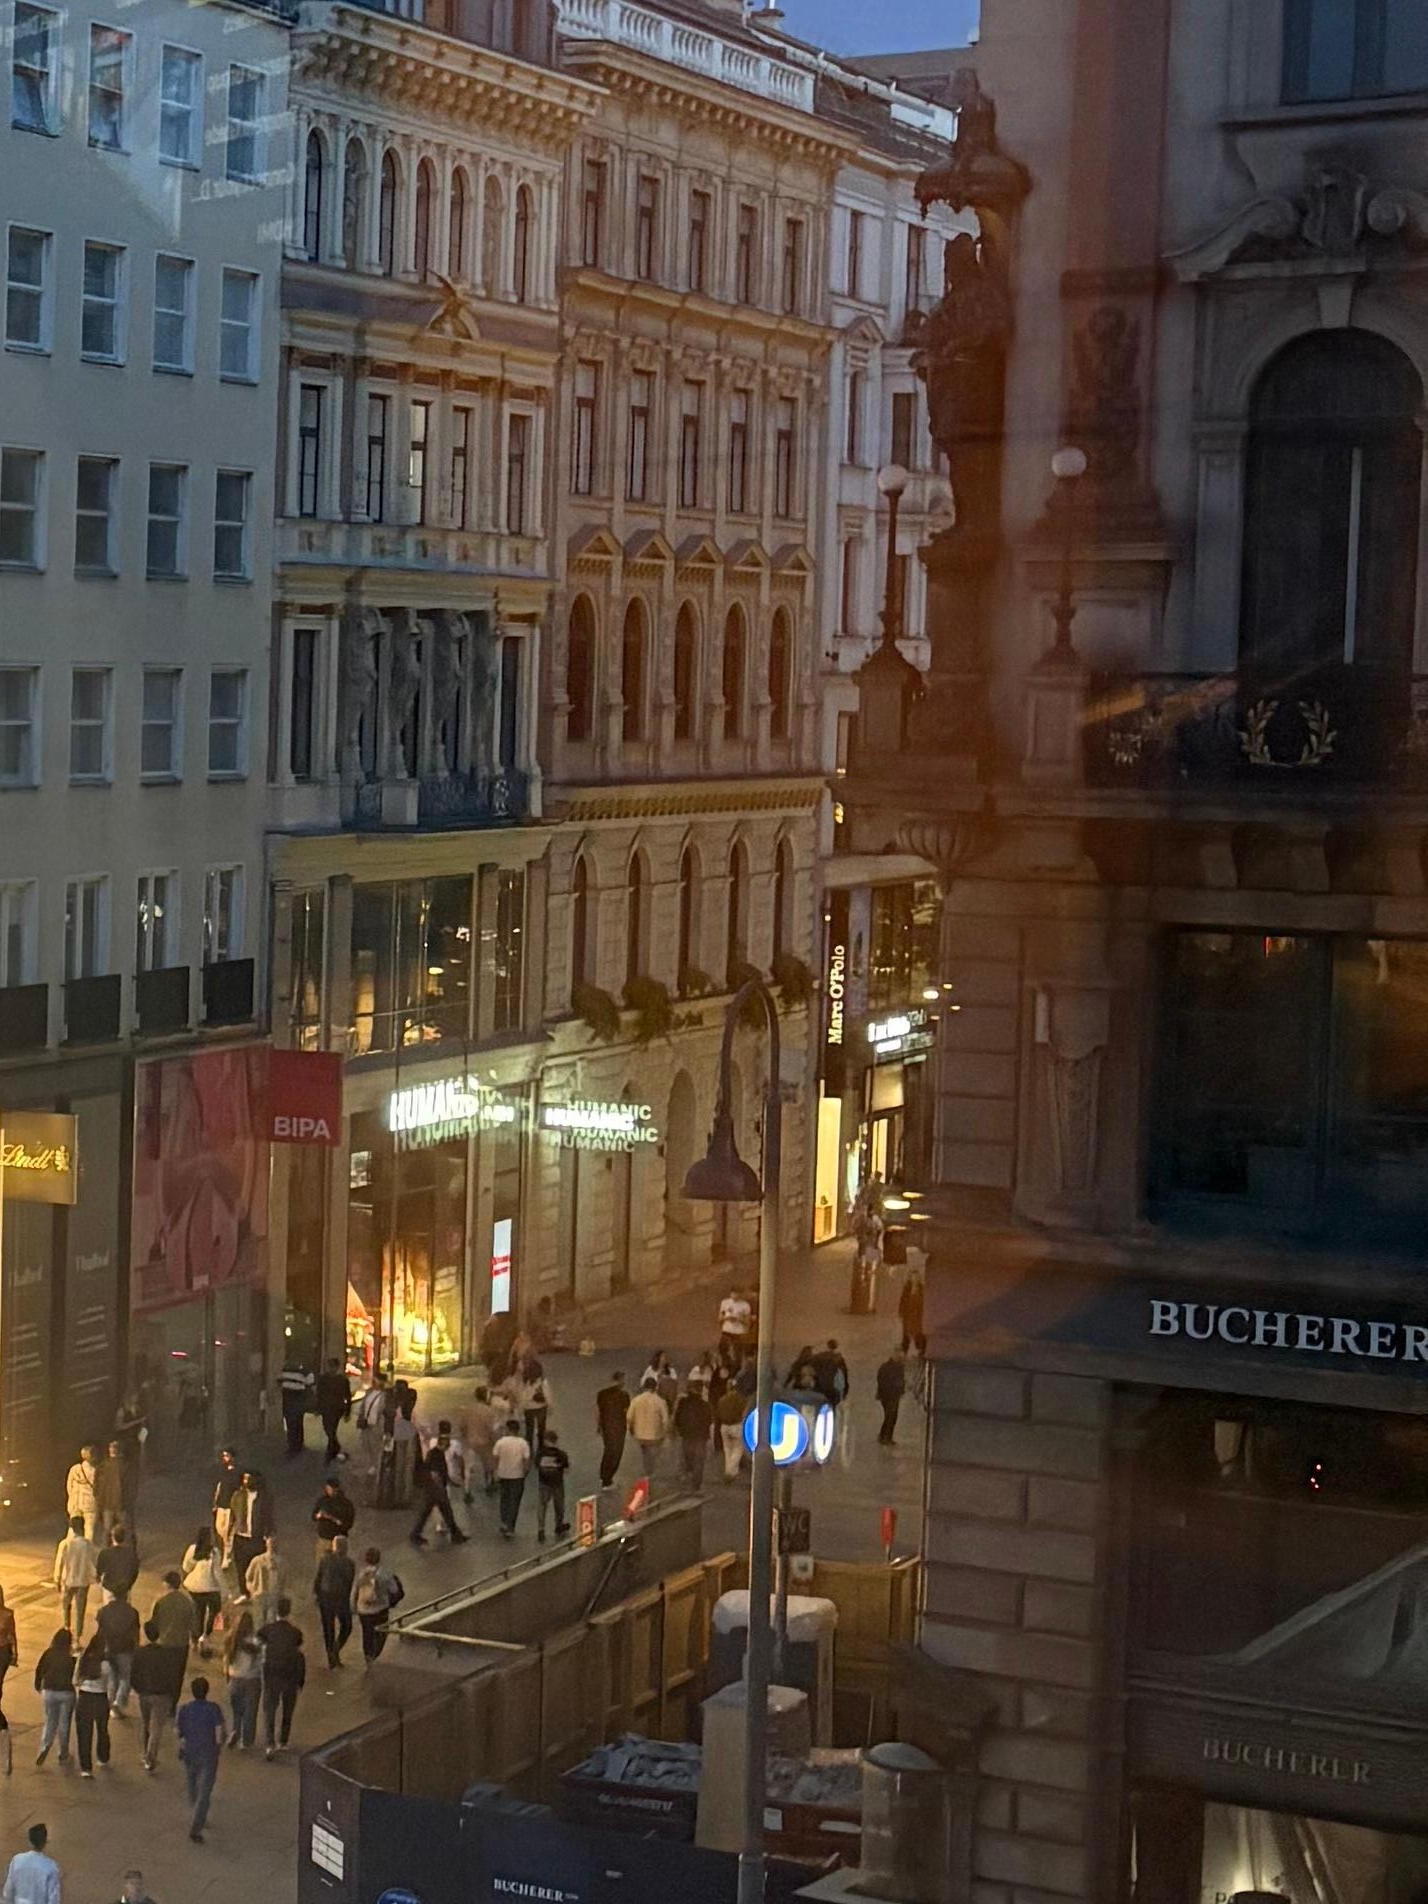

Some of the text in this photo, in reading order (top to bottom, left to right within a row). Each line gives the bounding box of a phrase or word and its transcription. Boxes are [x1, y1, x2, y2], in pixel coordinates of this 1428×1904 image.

[828, 1000, 844, 1045] Marc
[274, 1116, 331, 1139] BIPA
[0, 1144, 55, 1169] Lindt
[1149, 1299, 1428, 1361] BUCHERER
[1204, 1738, 1371, 1783] BUCHERER
[494, 1878, 564, 1903] BUCHERER
